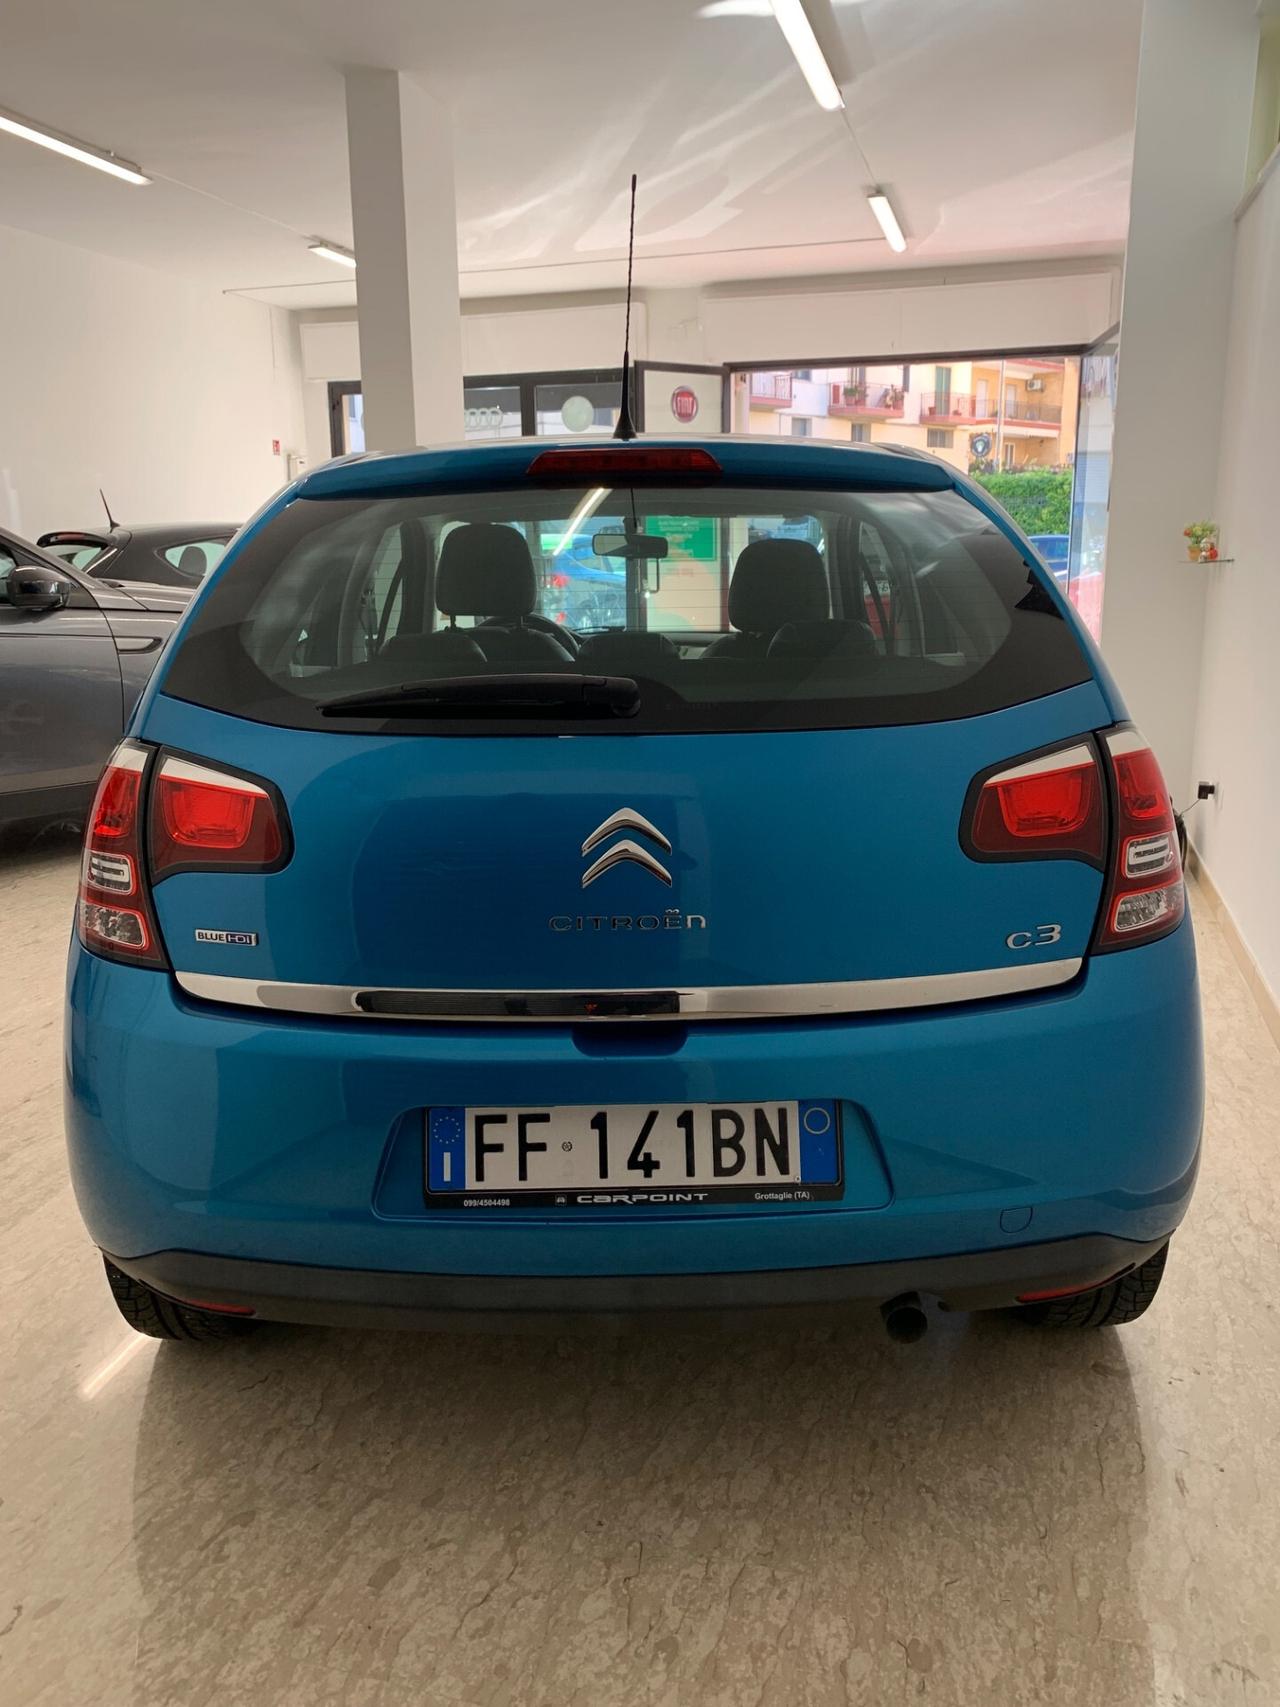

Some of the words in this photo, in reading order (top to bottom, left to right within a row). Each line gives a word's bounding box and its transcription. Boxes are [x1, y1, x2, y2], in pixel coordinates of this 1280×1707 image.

[1006, 923, 1062, 949] C3
[474, 1113, 551, 1182] FF
[590, 1107, 790, 1180] 141BN
[754, 1191, 793, 1201] Grottaglie
[794, 1190, 811, 1200] (TA)
